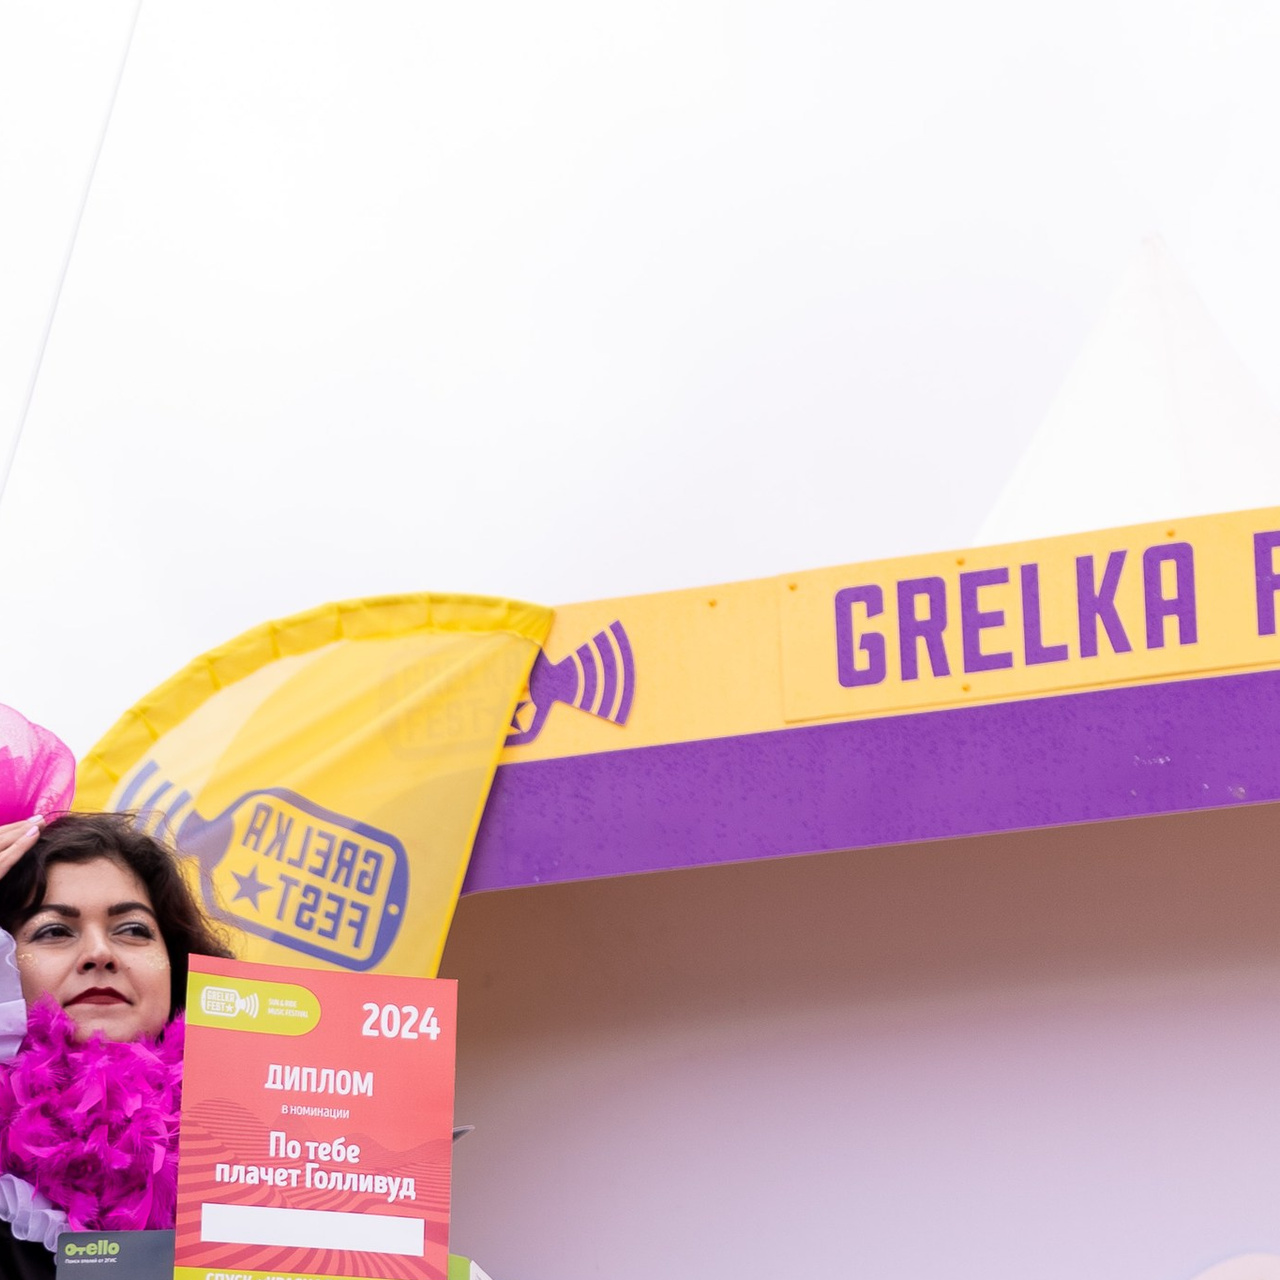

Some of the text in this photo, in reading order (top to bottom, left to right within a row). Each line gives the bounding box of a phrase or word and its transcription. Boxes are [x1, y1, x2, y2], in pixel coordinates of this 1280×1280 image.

[833, 541, 1199, 689] GRELKA
[361, 1002, 441, 1041] 2024
[264, 1064, 374, 1097] ДИПЛОМ
[281, 1104, 350, 1119] в номинации
[269, 1131, 361, 1164] По тебе
[215, 1162, 417, 1203] плачет Голливуд
